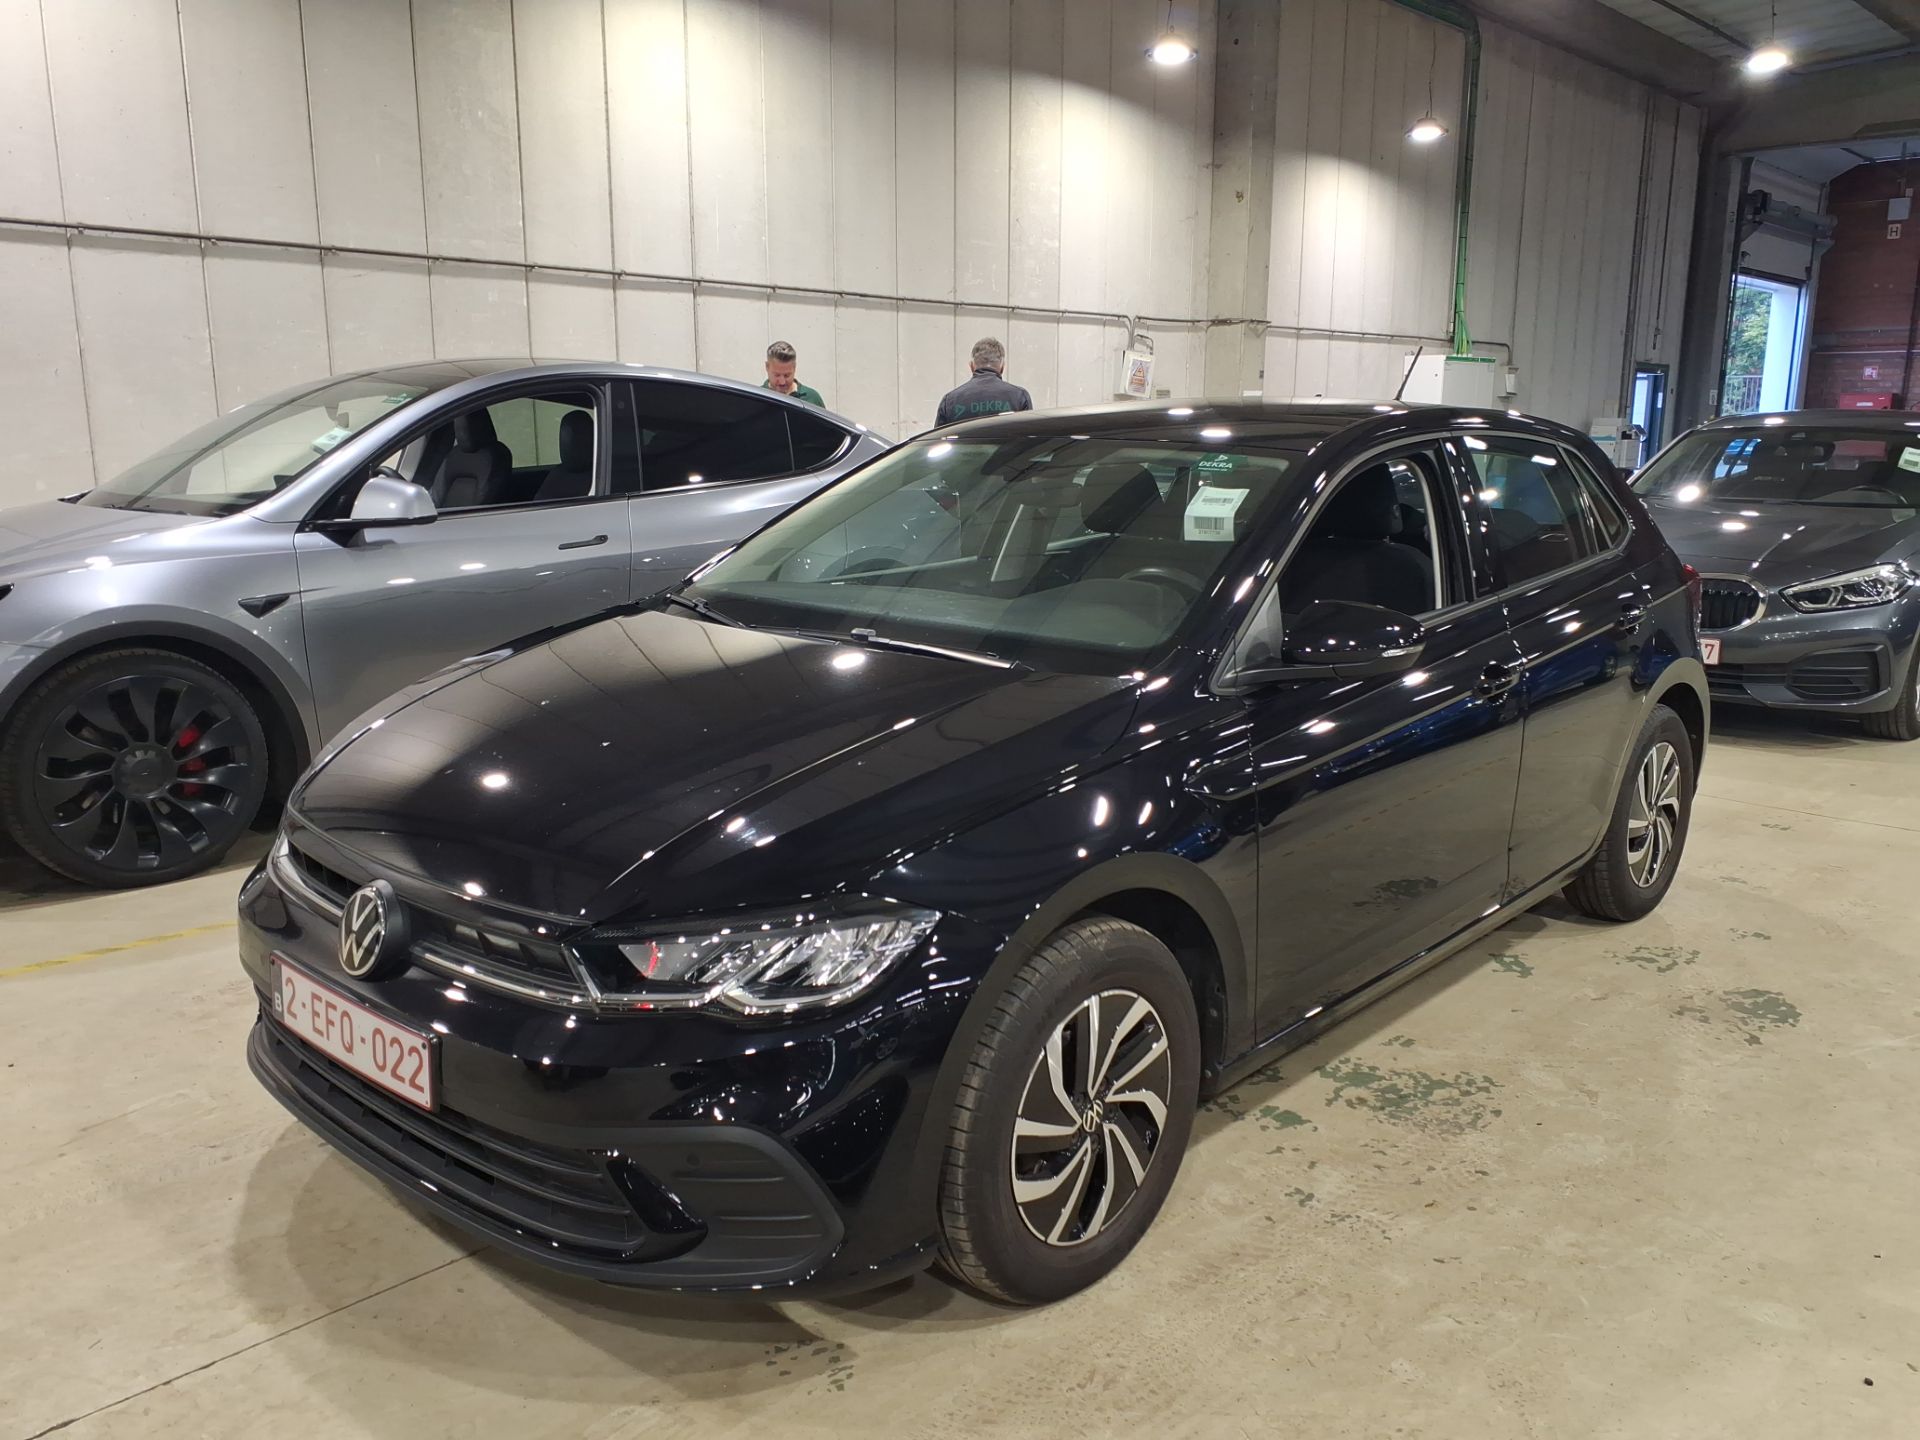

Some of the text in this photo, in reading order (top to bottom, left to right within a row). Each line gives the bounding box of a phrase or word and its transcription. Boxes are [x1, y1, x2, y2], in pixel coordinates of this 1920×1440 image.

[970, 400, 1011, 413] DEKRA
[1198, 461, 1232, 469] DEKRA
[285, 976, 425, 1094] 2-EFQ-022
